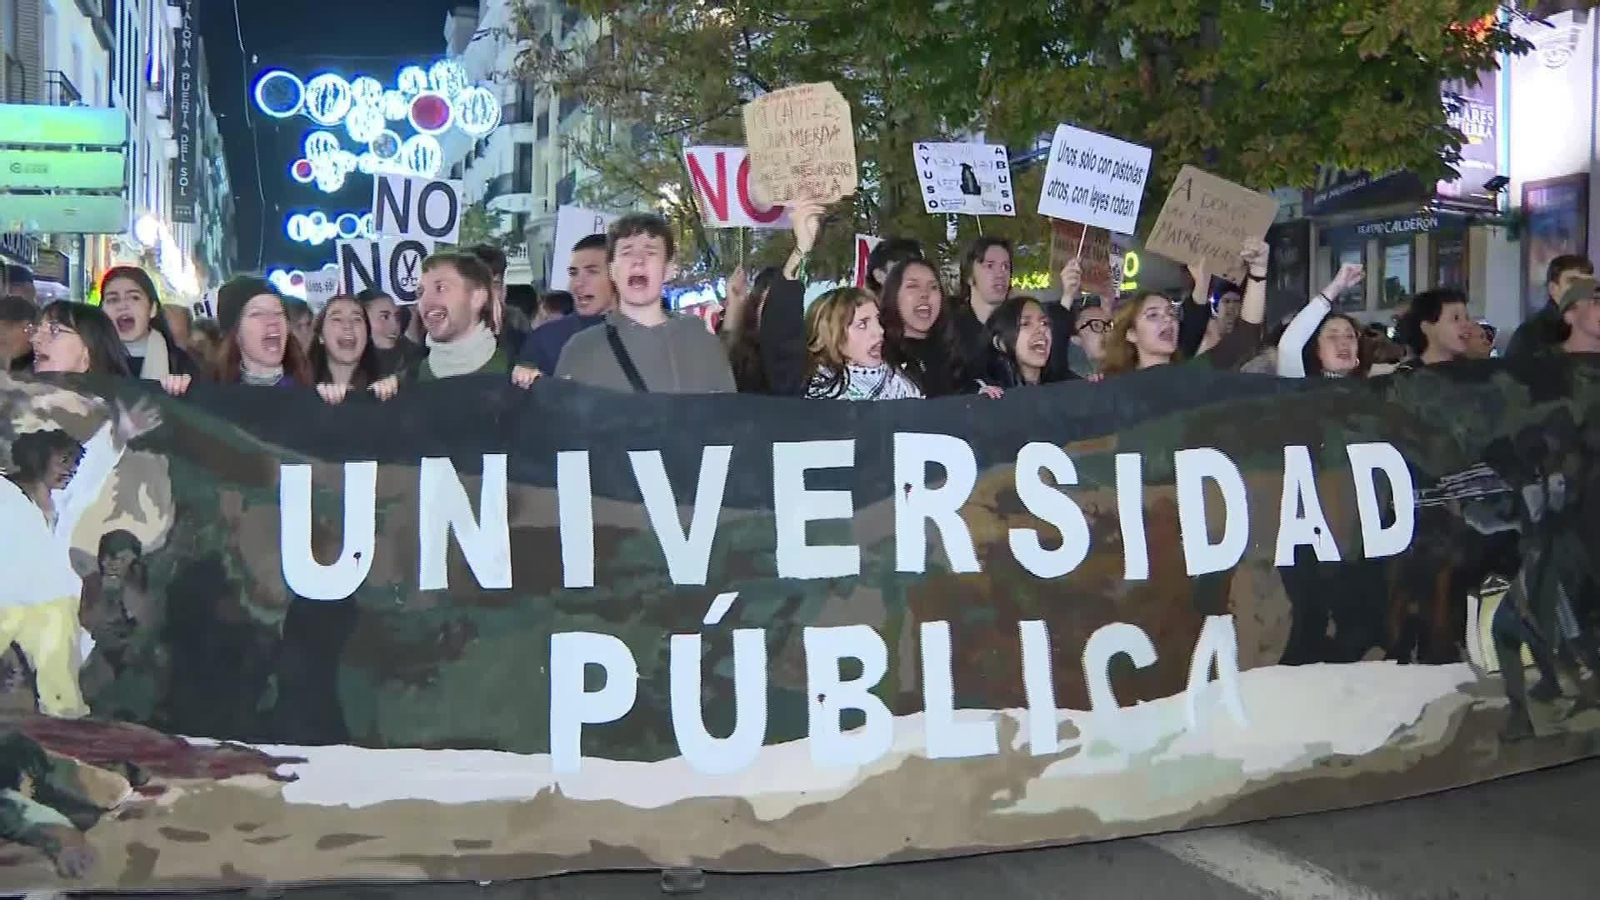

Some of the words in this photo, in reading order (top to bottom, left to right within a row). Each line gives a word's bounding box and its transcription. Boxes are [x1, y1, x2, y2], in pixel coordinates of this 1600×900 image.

[181, 72, 191, 130] PUERTA
[180, 134, 189, 163] DEL
[789, 124, 841, 148] MIERDA
[1078, 146, 1097, 171] sólo
[1097, 155, 1112, 175] con
[179, 167, 189, 196] SOL
[918, 143, 939, 210] AYUSO
[994, 146, 1013, 213] ABUSO
[1047, 176, 1070, 205] otros,
[1071, 185, 1089, 205] con
[1089, 184, 1110, 214] leyes
[374, 175, 459, 239] NO
[341, 239, 429, 302] NO
[279, 431, 1416, 601] UNIVERSIDAD
[549, 591, 1250, 777] PÚBLICA
